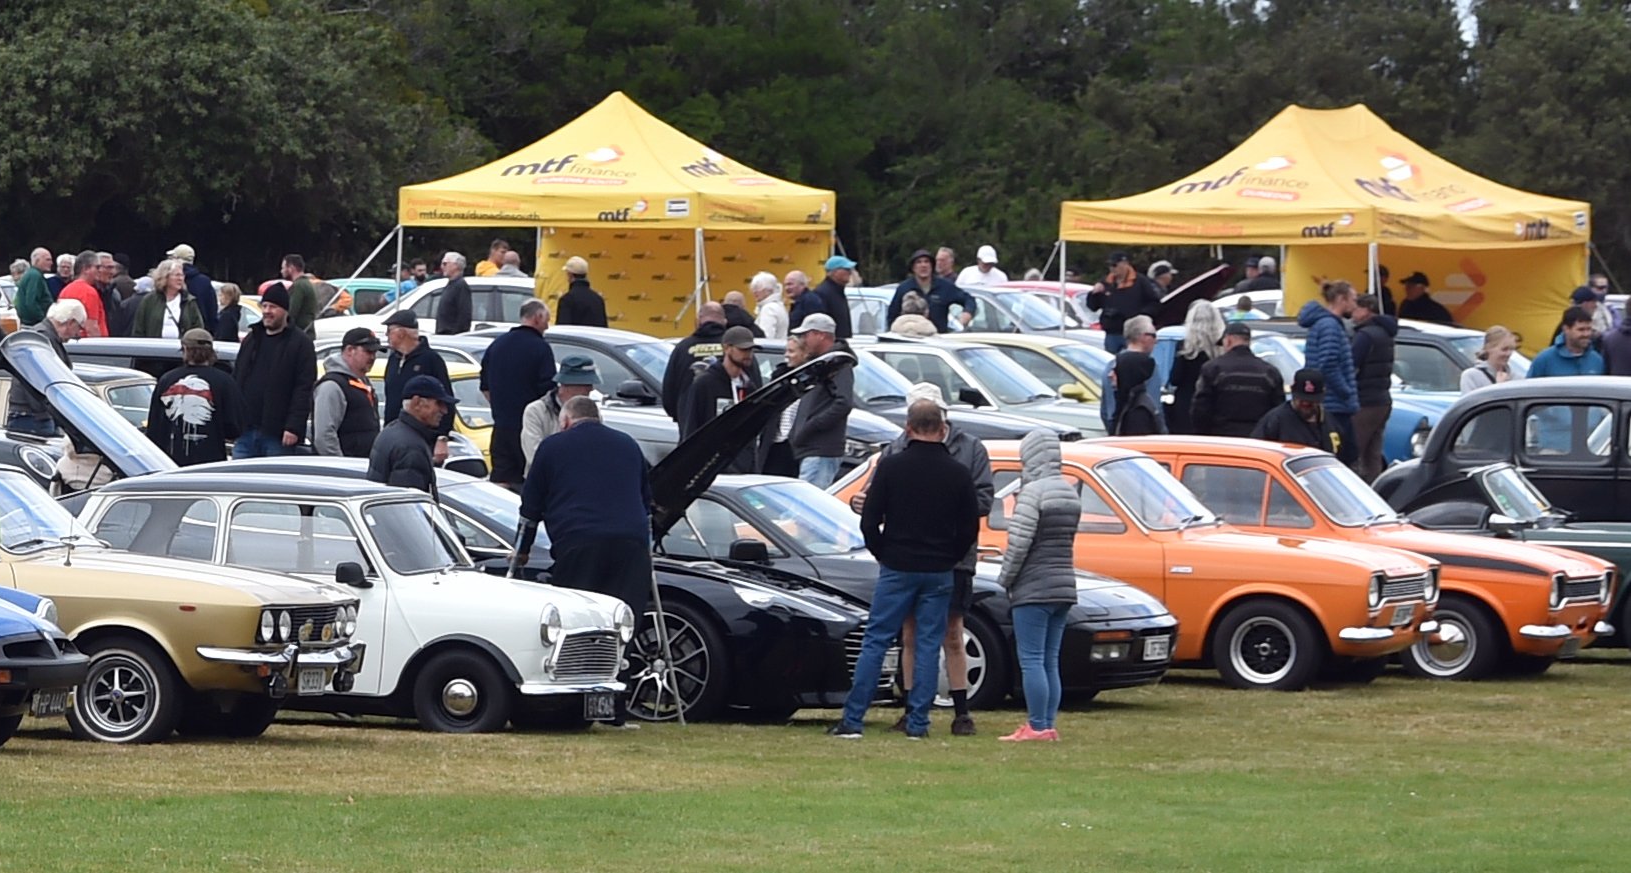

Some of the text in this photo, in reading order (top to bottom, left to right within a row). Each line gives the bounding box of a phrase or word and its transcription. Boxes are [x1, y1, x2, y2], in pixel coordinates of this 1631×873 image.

[501, 154, 638, 178] mtf finance
[1171, 167, 1309, 195] mtf finance
[597, 208, 631, 222] mtf
[1301, 222, 1335, 238] mtf
